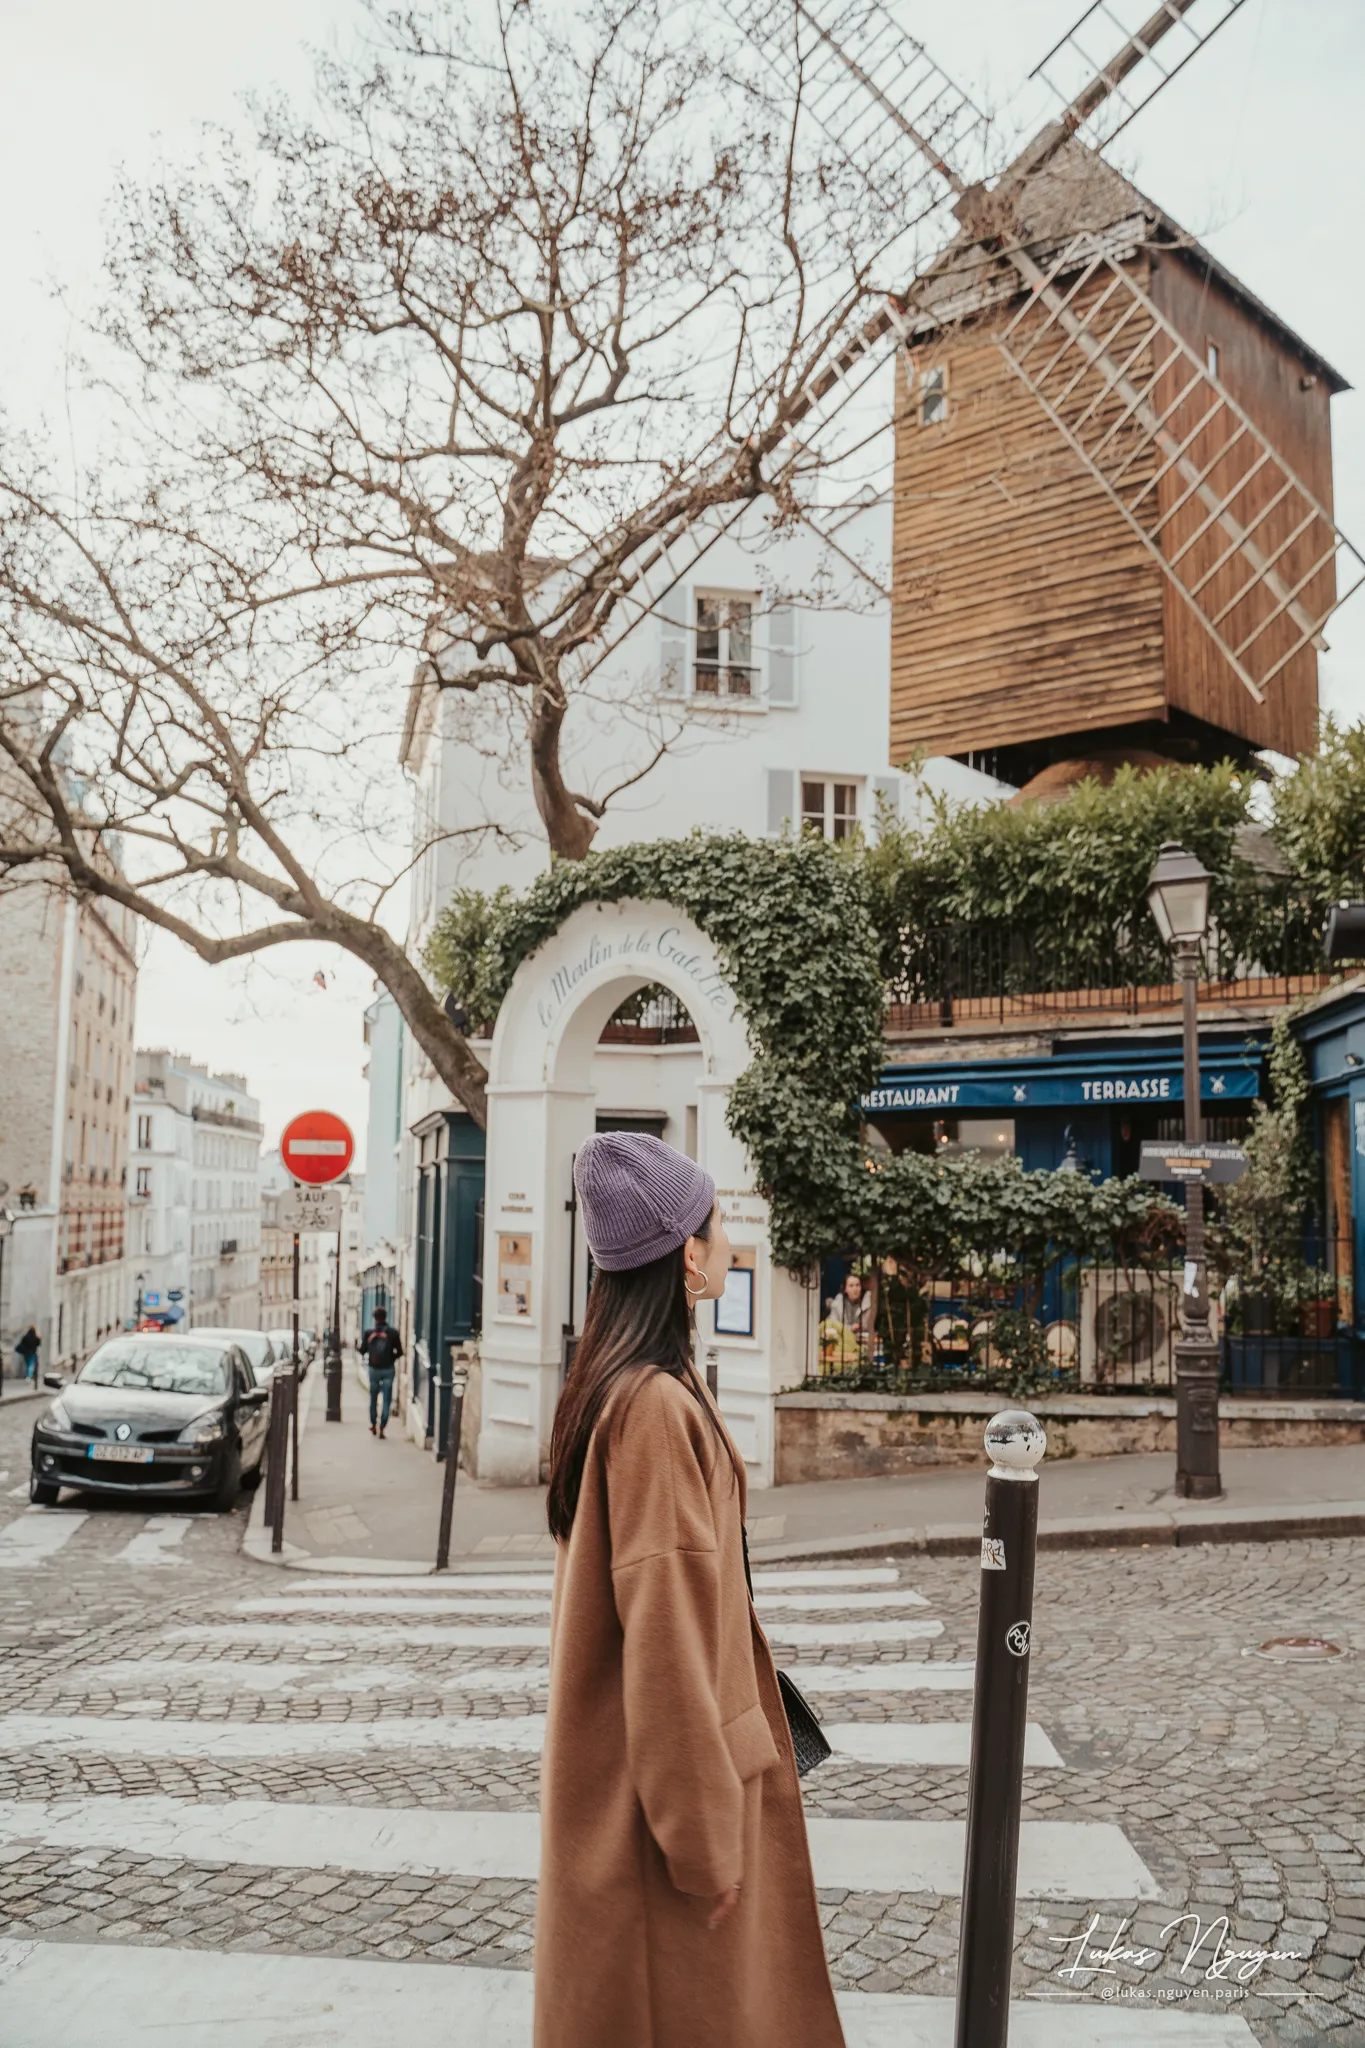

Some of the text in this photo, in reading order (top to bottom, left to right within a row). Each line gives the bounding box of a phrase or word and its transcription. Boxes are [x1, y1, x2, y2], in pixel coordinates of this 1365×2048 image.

[551, 933, 612, 1004] Moulin
[618, 933, 634, 955] de
[636, 929, 651, 954] la
[657, 926, 728, 1012] Galette
[1081, 1077, 1170, 1101] TERRASSE
[296, 1191, 328, 1203] SAUF
